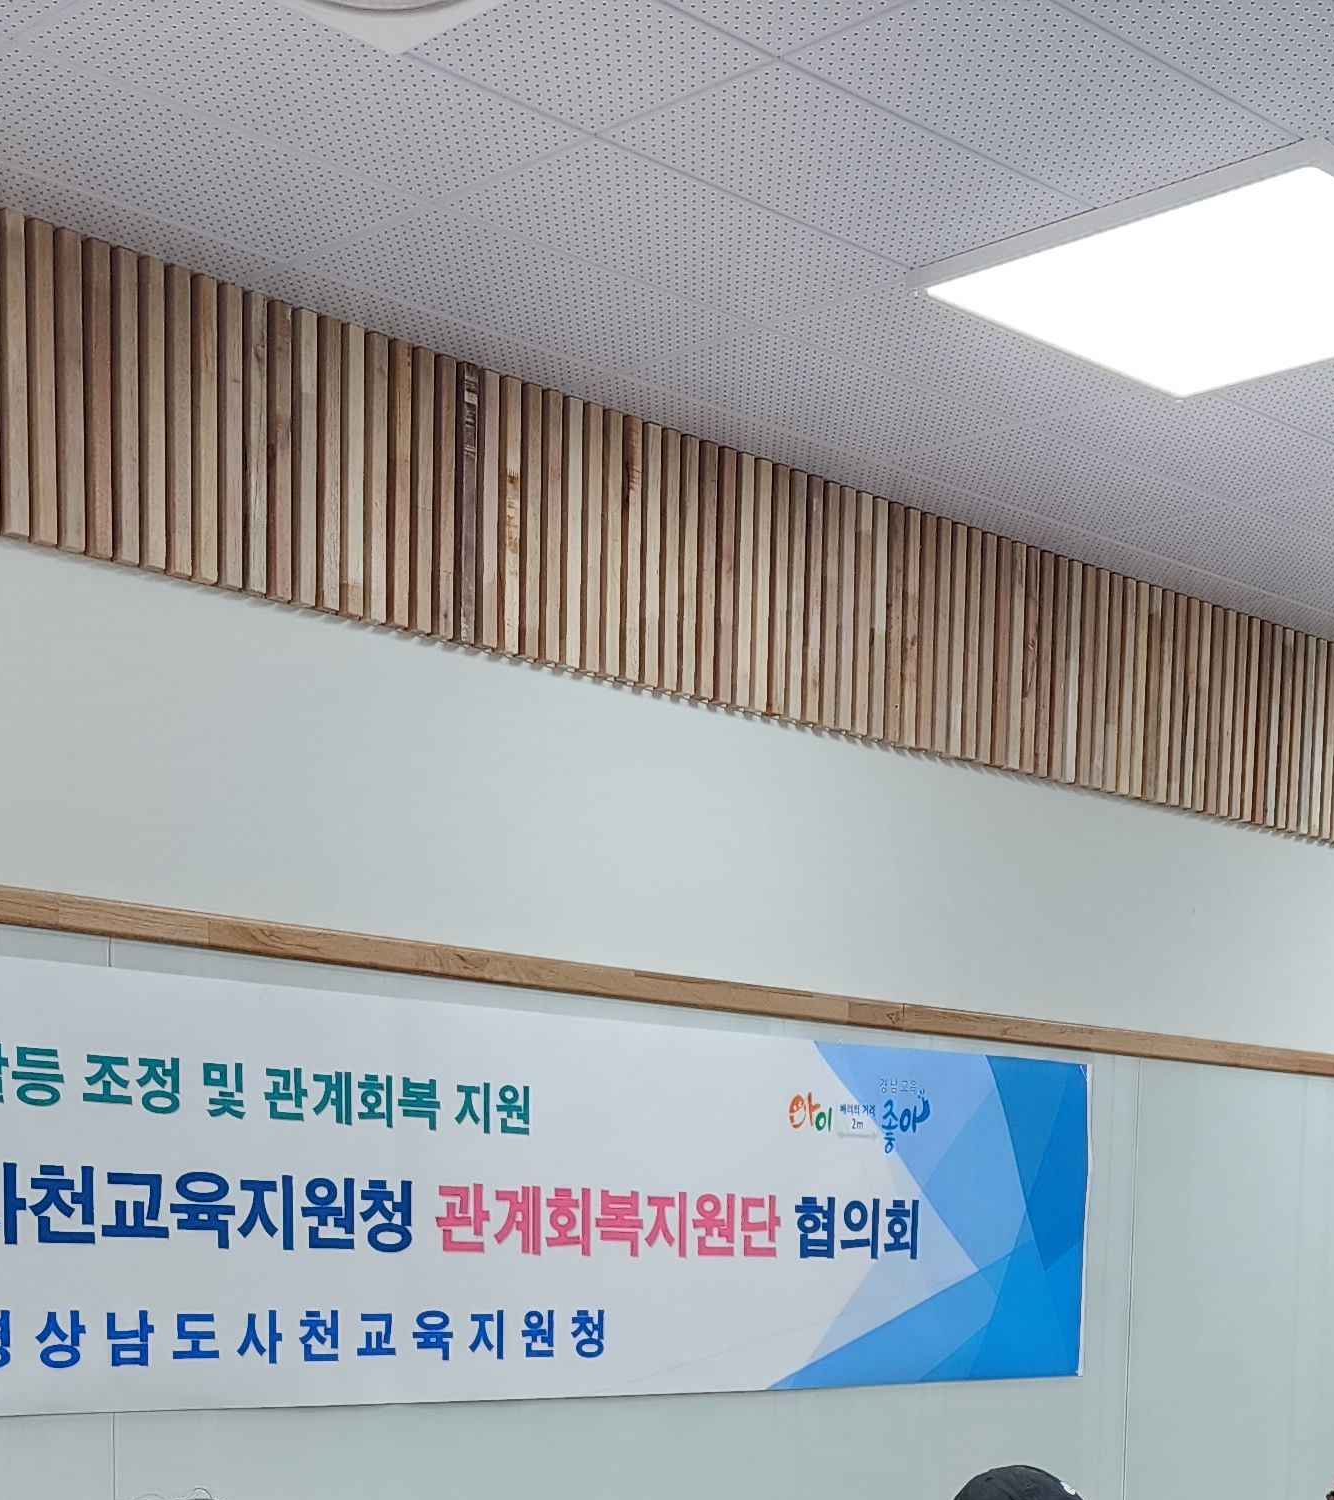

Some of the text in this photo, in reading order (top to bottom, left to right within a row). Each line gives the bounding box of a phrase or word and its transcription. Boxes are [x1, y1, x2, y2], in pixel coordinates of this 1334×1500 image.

[82, 1052, 182, 1116] 조정
[202, 1061, 247, 1120] 및
[263, 1066, 442, 1132] 관계회복
[454, 1081, 532, 1136] 지원
[879, 1078, 917, 1094] 경남교육
[851, 1118, 864, 1130] 2m
[881, 1091, 931, 1155] 좋아
[435, 1182, 782, 1259] 관계회복지원단
[794, 1194, 921, 1260] 협의회
